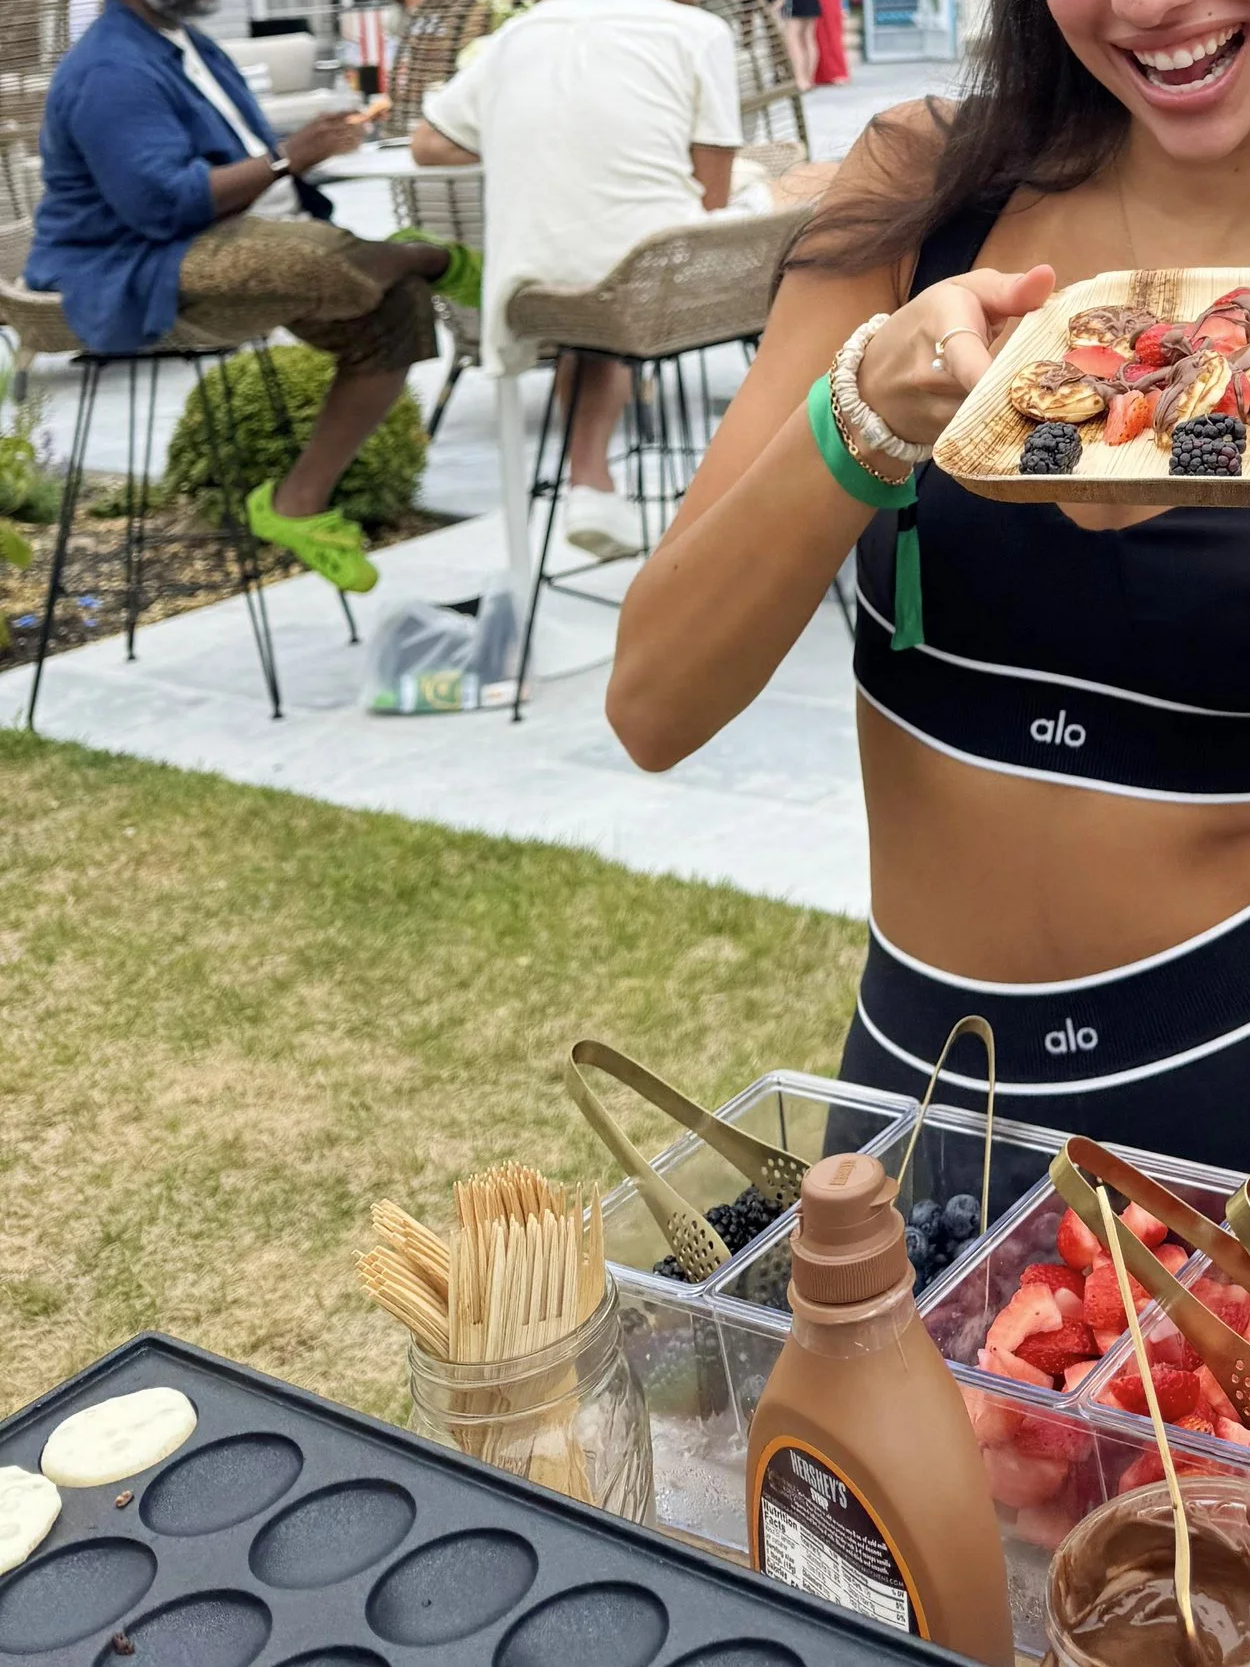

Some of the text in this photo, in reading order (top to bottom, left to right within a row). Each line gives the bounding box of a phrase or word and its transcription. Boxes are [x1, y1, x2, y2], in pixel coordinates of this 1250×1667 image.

[1030, 709, 1086, 748] alo
[1045, 1017, 1098, 1054] alo
[789, 1449, 848, 1509] HERSHEY'S
[763, 1500, 798, 1531] Nutrition
[764, 1511, 786, 1534] Facts
